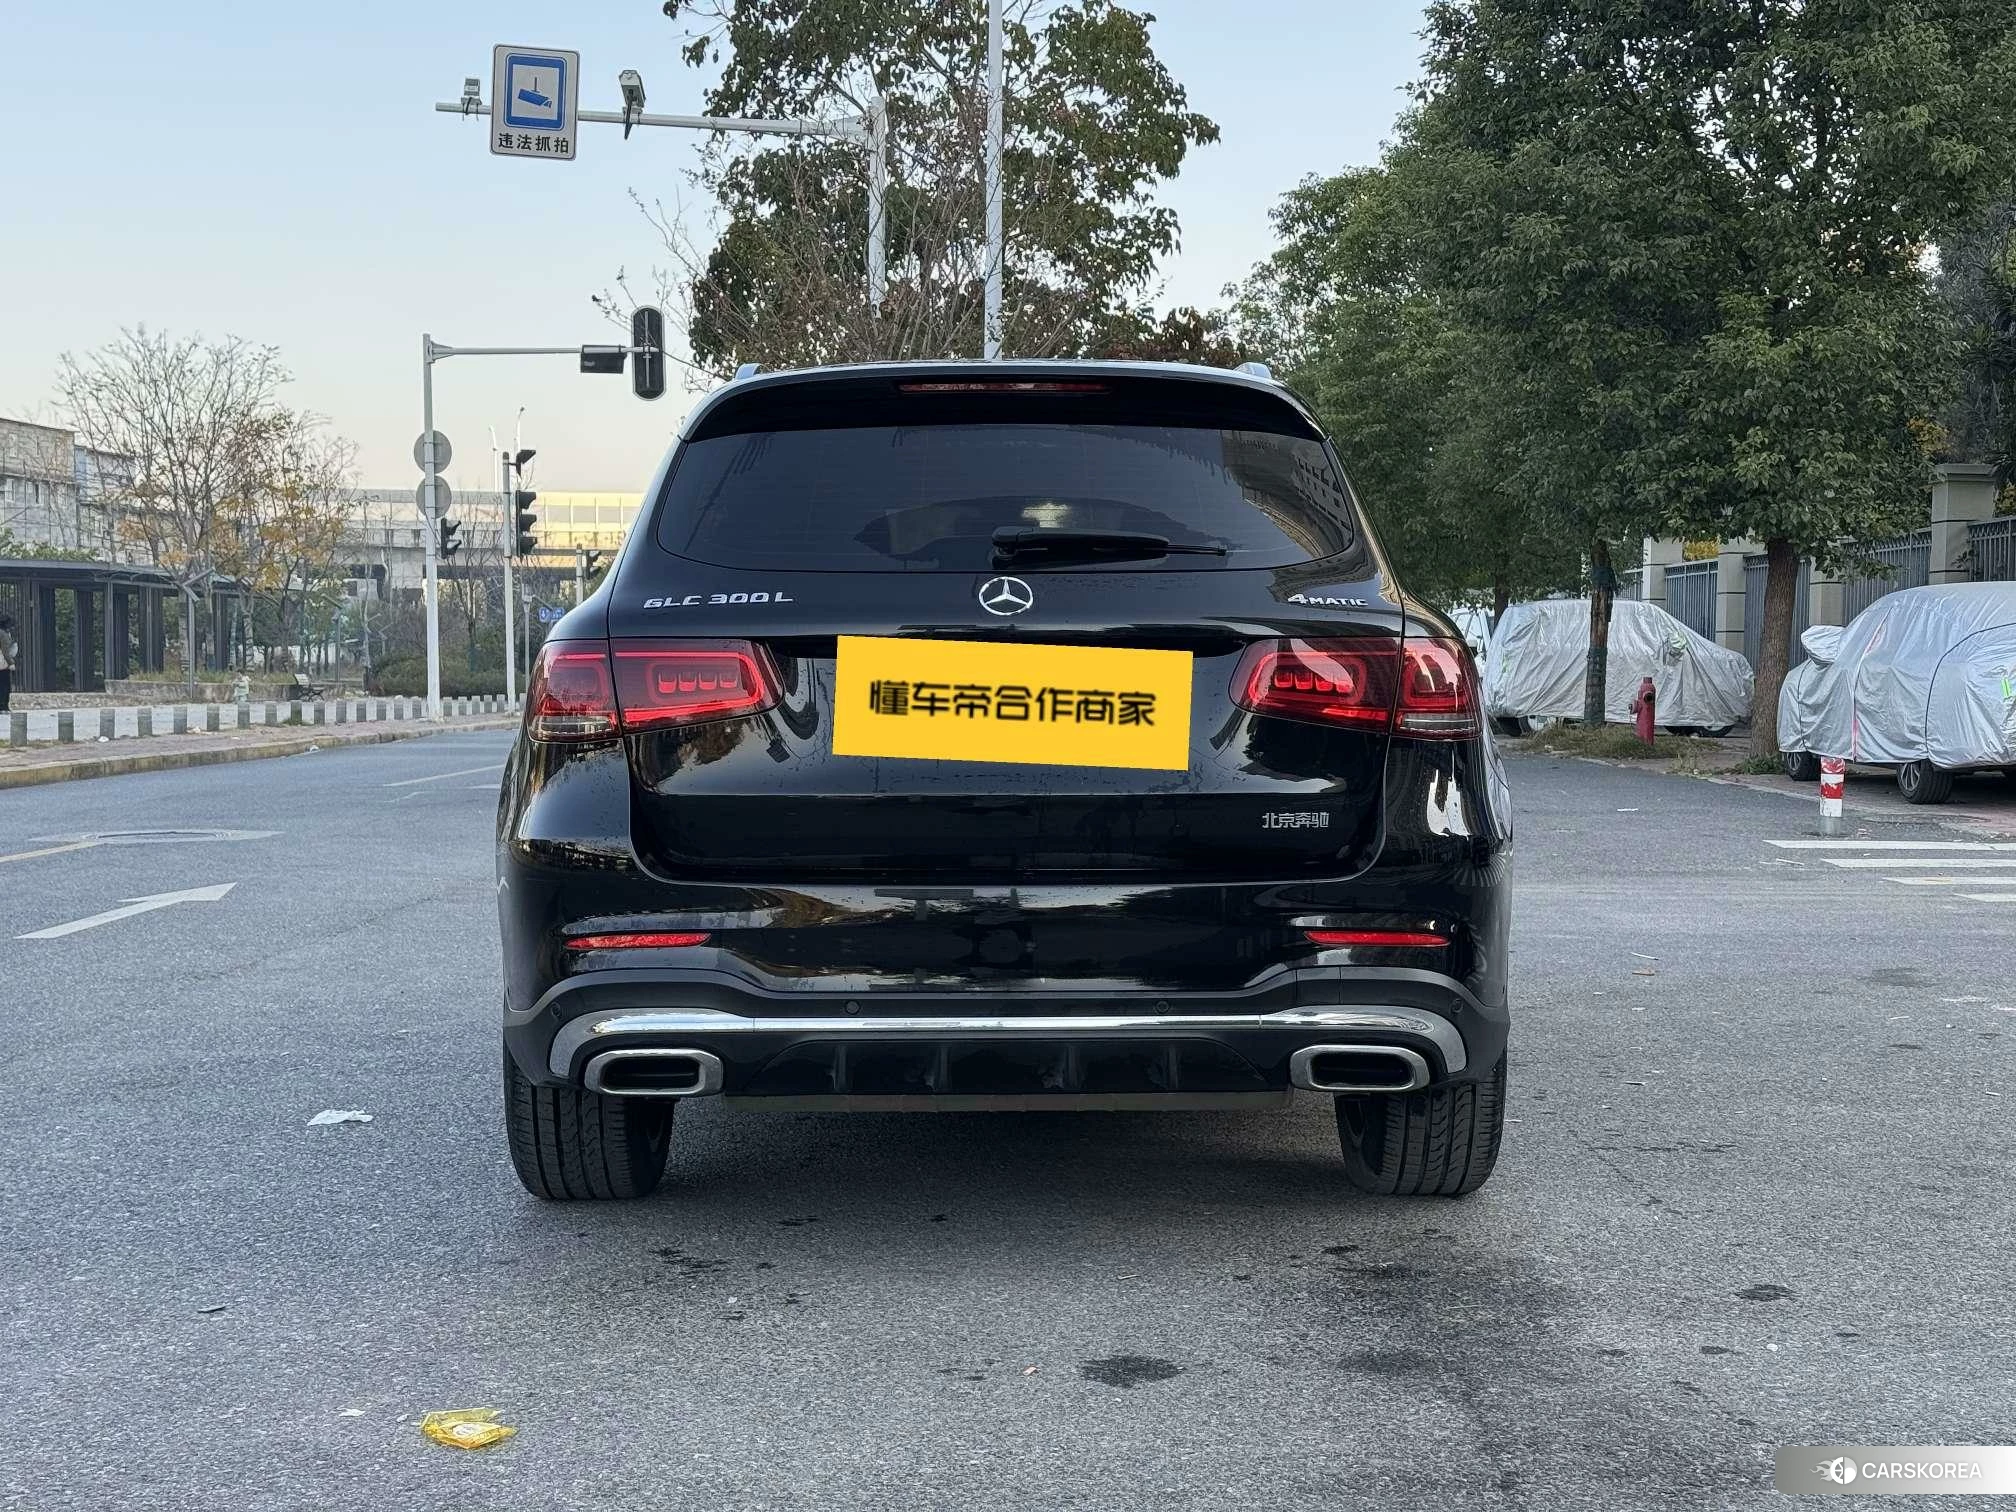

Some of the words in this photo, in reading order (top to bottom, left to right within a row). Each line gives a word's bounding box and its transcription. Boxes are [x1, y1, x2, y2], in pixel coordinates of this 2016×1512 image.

[498, 132, 569, 153] 违法抓拍
[643, 595, 703, 609] GLC
[707, 592, 770, 605] 300
[774, 591, 793, 603] L
[1287, 593, 1369, 606] 4MATIC
[1262, 812, 1330, 828] 北京奔驰
